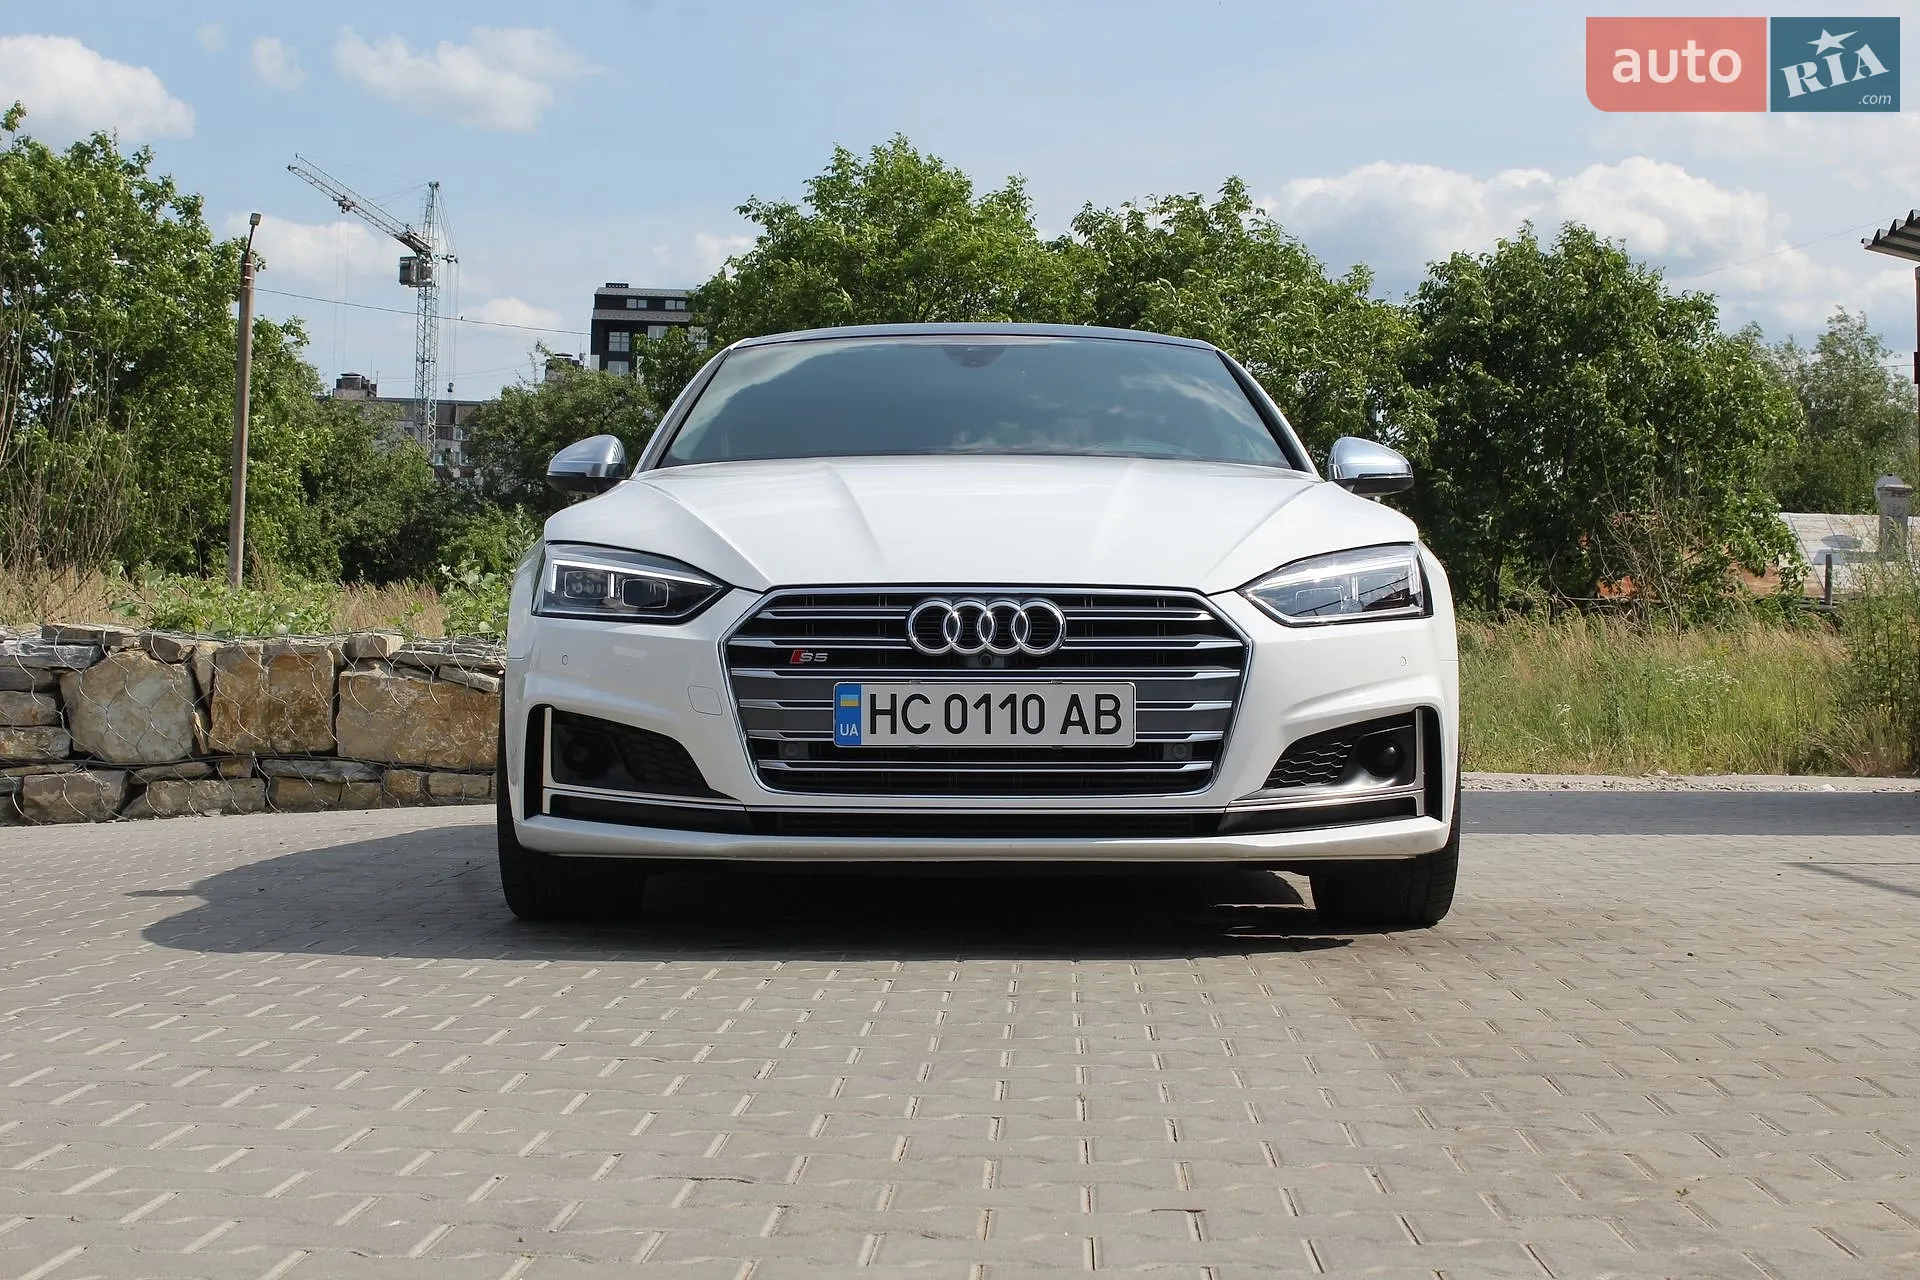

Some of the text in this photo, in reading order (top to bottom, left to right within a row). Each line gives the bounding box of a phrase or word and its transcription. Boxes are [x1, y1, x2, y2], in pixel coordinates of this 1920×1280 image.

[798, 651, 828, 664] S5
[869, 692, 1122, 736] HC 0110 AB
[840, 724, 859, 737] UA
